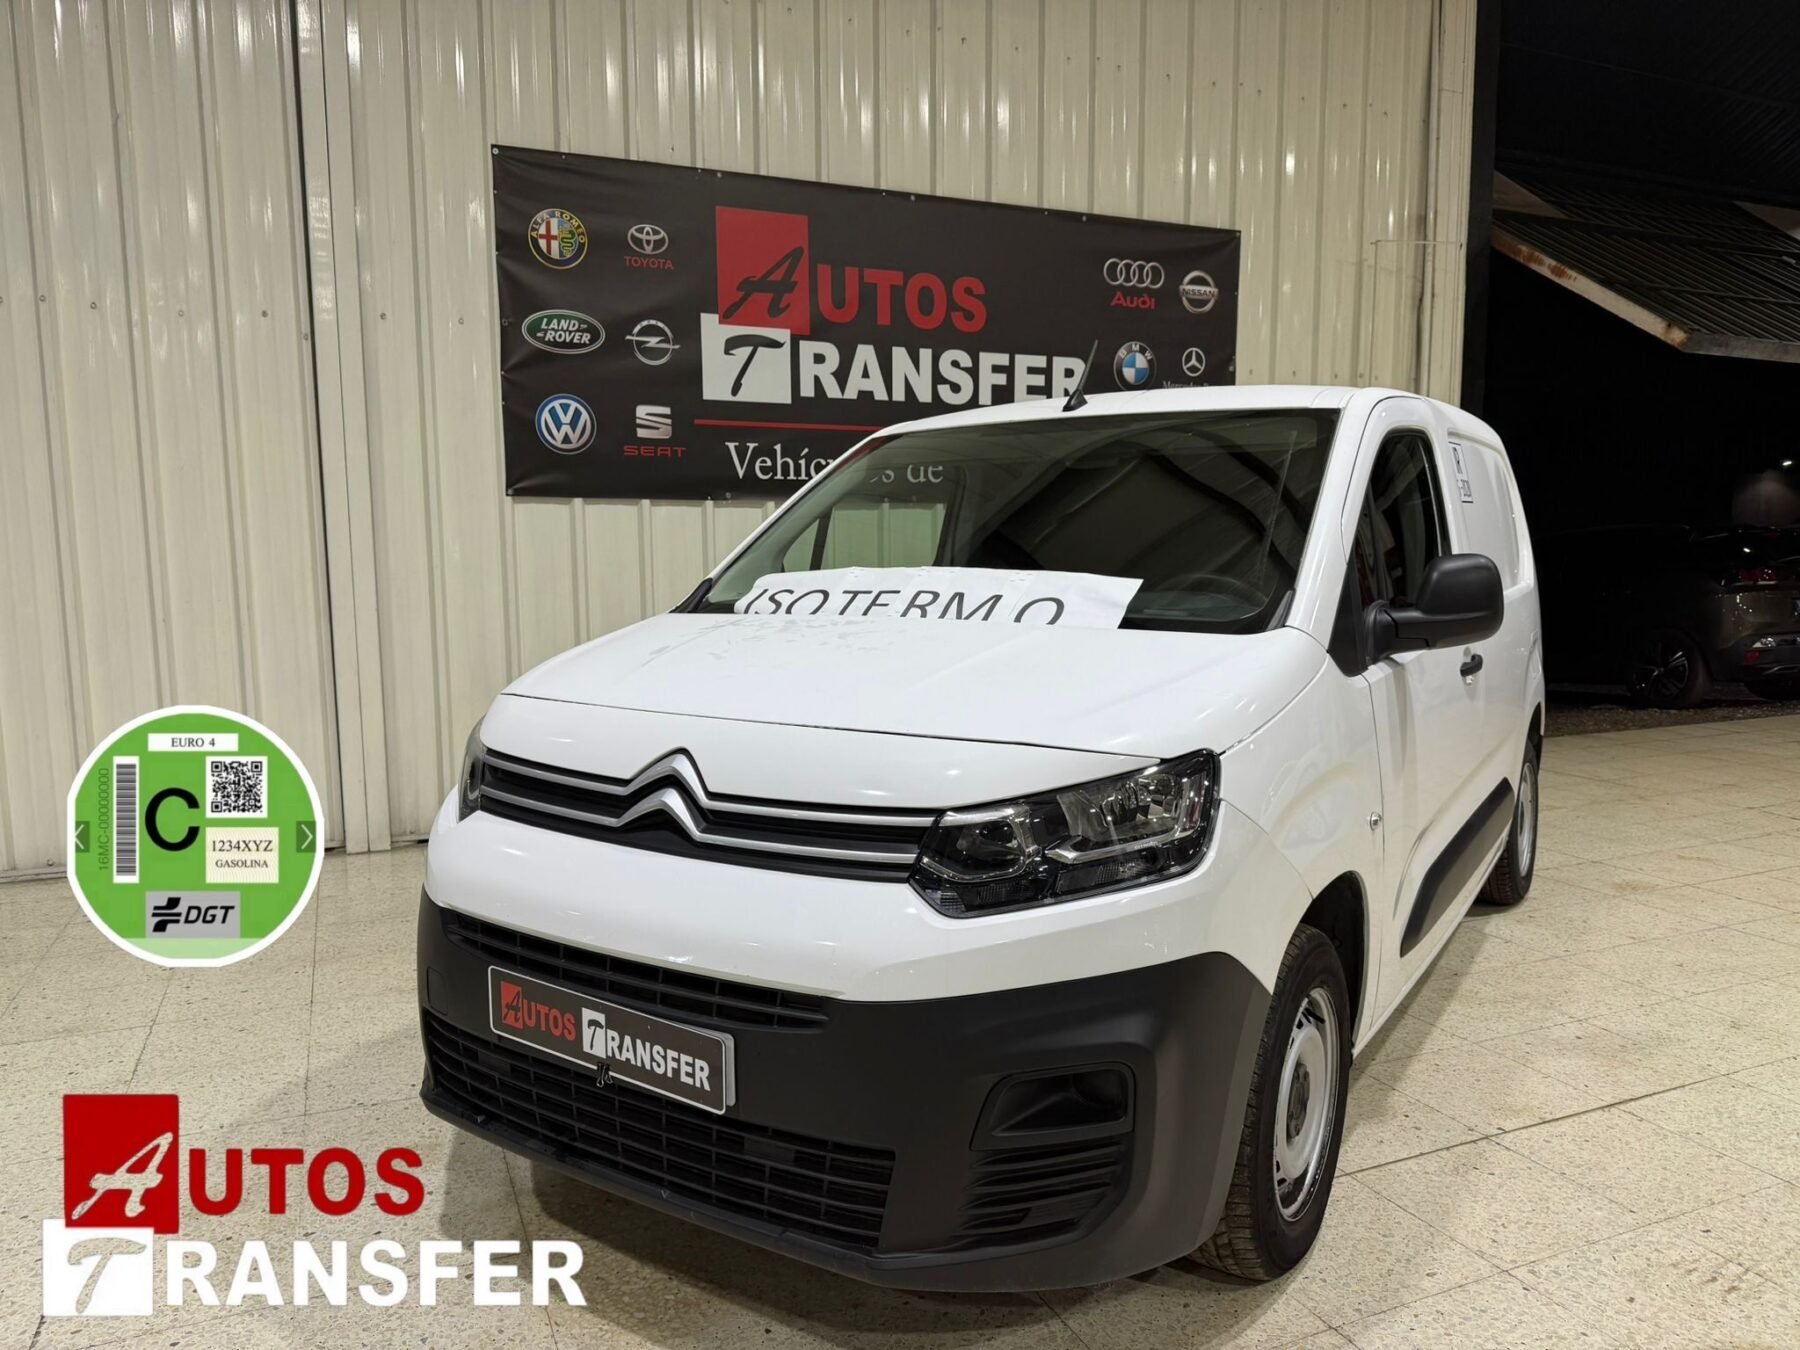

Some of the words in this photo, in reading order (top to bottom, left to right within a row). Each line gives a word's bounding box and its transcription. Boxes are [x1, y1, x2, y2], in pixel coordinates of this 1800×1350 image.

[530, 211, 551, 239] ALFA
[555, 210, 586, 243] ROMEO
[624, 255, 674, 270] TOYOTA
[722, 246, 987, 333] AUTOS
[1182, 286, 1216, 298] NISSAN
[1111, 291, 1156, 310] Audi
[541, 318, 579, 331] LAND
[544, 330, 591, 344] ROVER
[1119, 343, 1153, 360] BMW
[724, 334, 1086, 406] TRANSFER
[623, 445, 686, 457] SEAT
[503, 991, 577, 1041] AUTOS
[587, 1018, 711, 1092] TRANSFER
